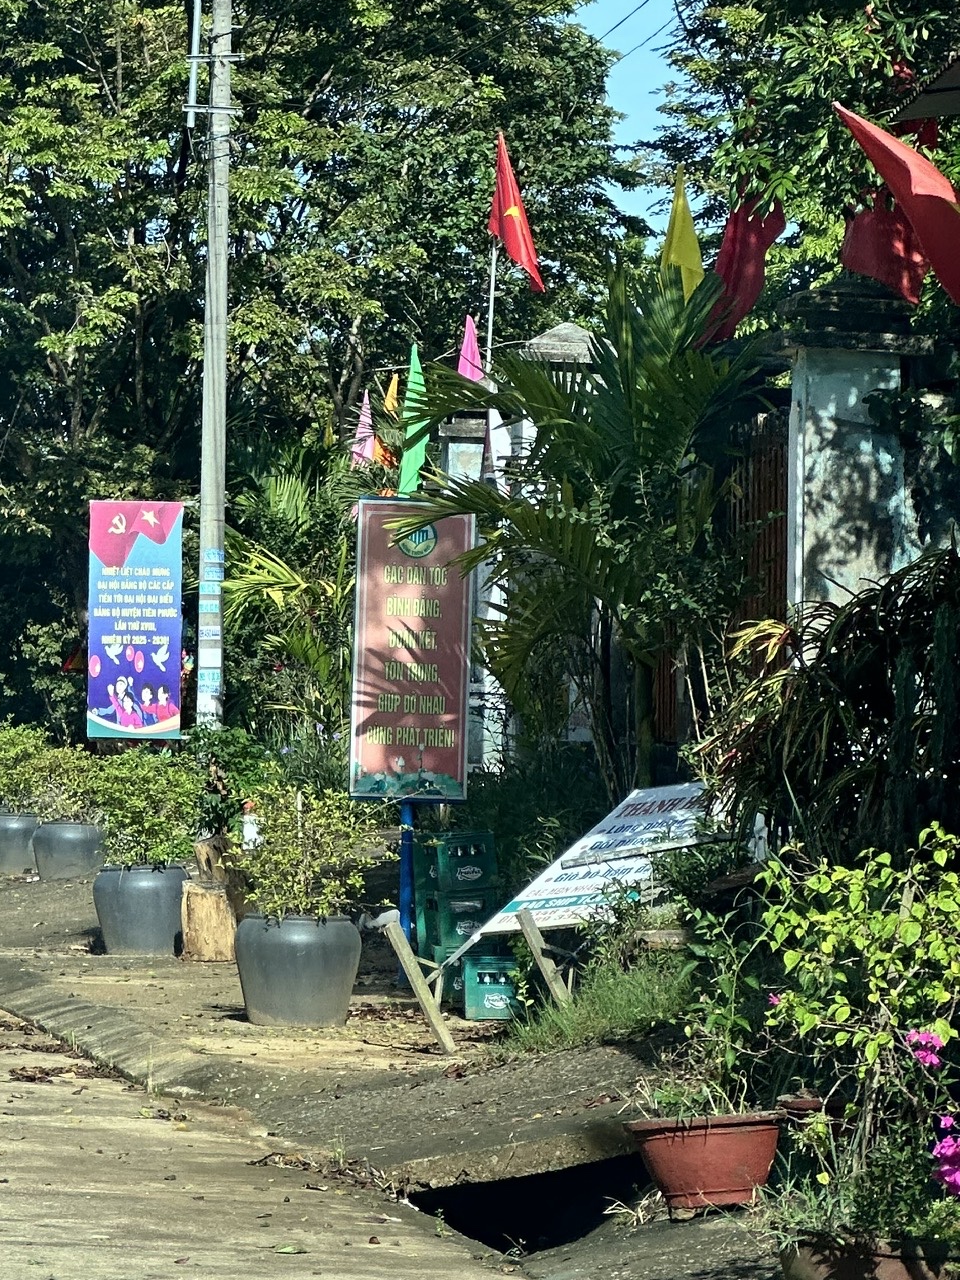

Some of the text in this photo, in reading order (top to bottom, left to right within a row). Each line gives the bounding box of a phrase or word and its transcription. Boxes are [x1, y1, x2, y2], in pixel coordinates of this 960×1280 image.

[384, 562, 448, 589] CÁC DÂN TỘC
[386, 593, 412, 617] BÌNH
[384, 658, 404, 681] TÔN
[378, 690, 446, 715] GIÚP ĐỠ NHAU
[366, 722, 455, 747] CÙNG PHÁT TRIỂN!
[544, 896, 578, 908] SHIP
